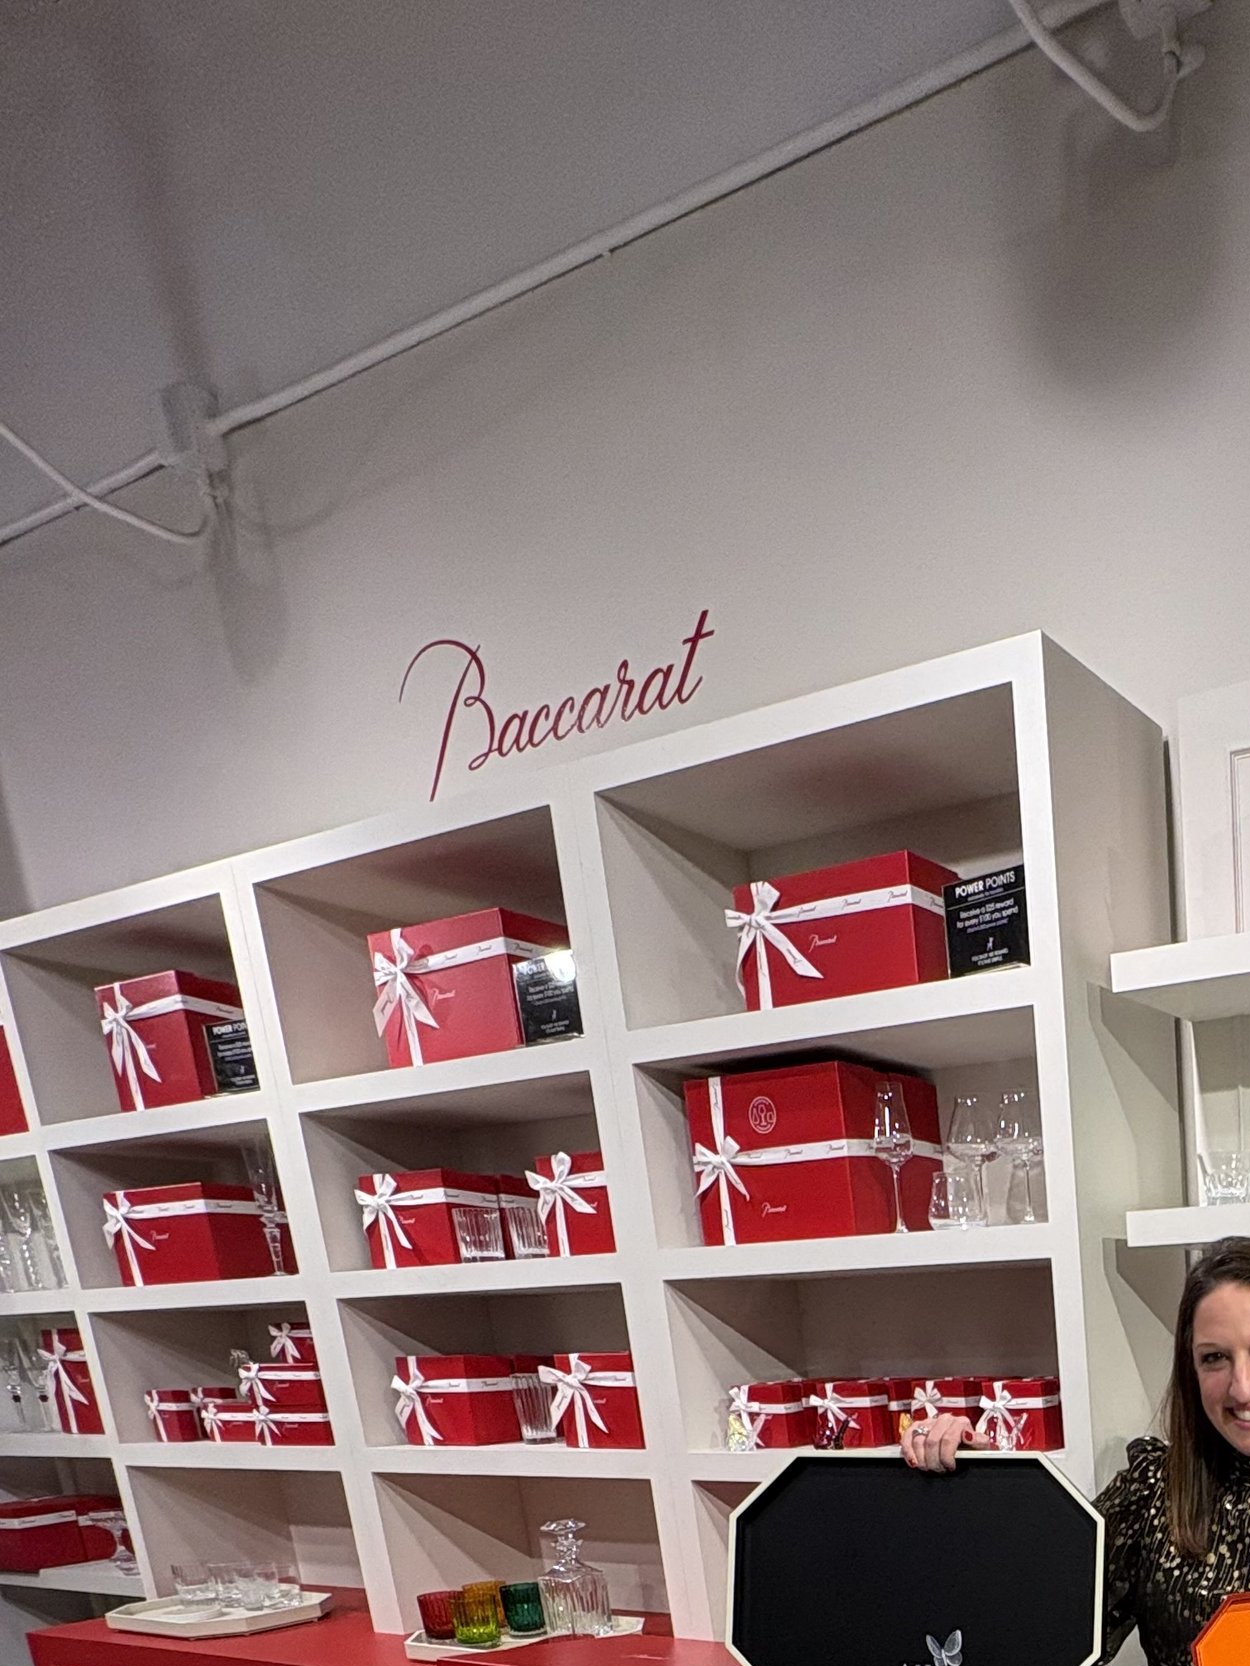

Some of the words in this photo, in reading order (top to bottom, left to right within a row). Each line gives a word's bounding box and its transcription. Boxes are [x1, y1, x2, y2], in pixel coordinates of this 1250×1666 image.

[399, 609, 715, 802] Baccarat
[955, 880, 984, 899] POWER
[986, 871, 1016, 889] POINTS
